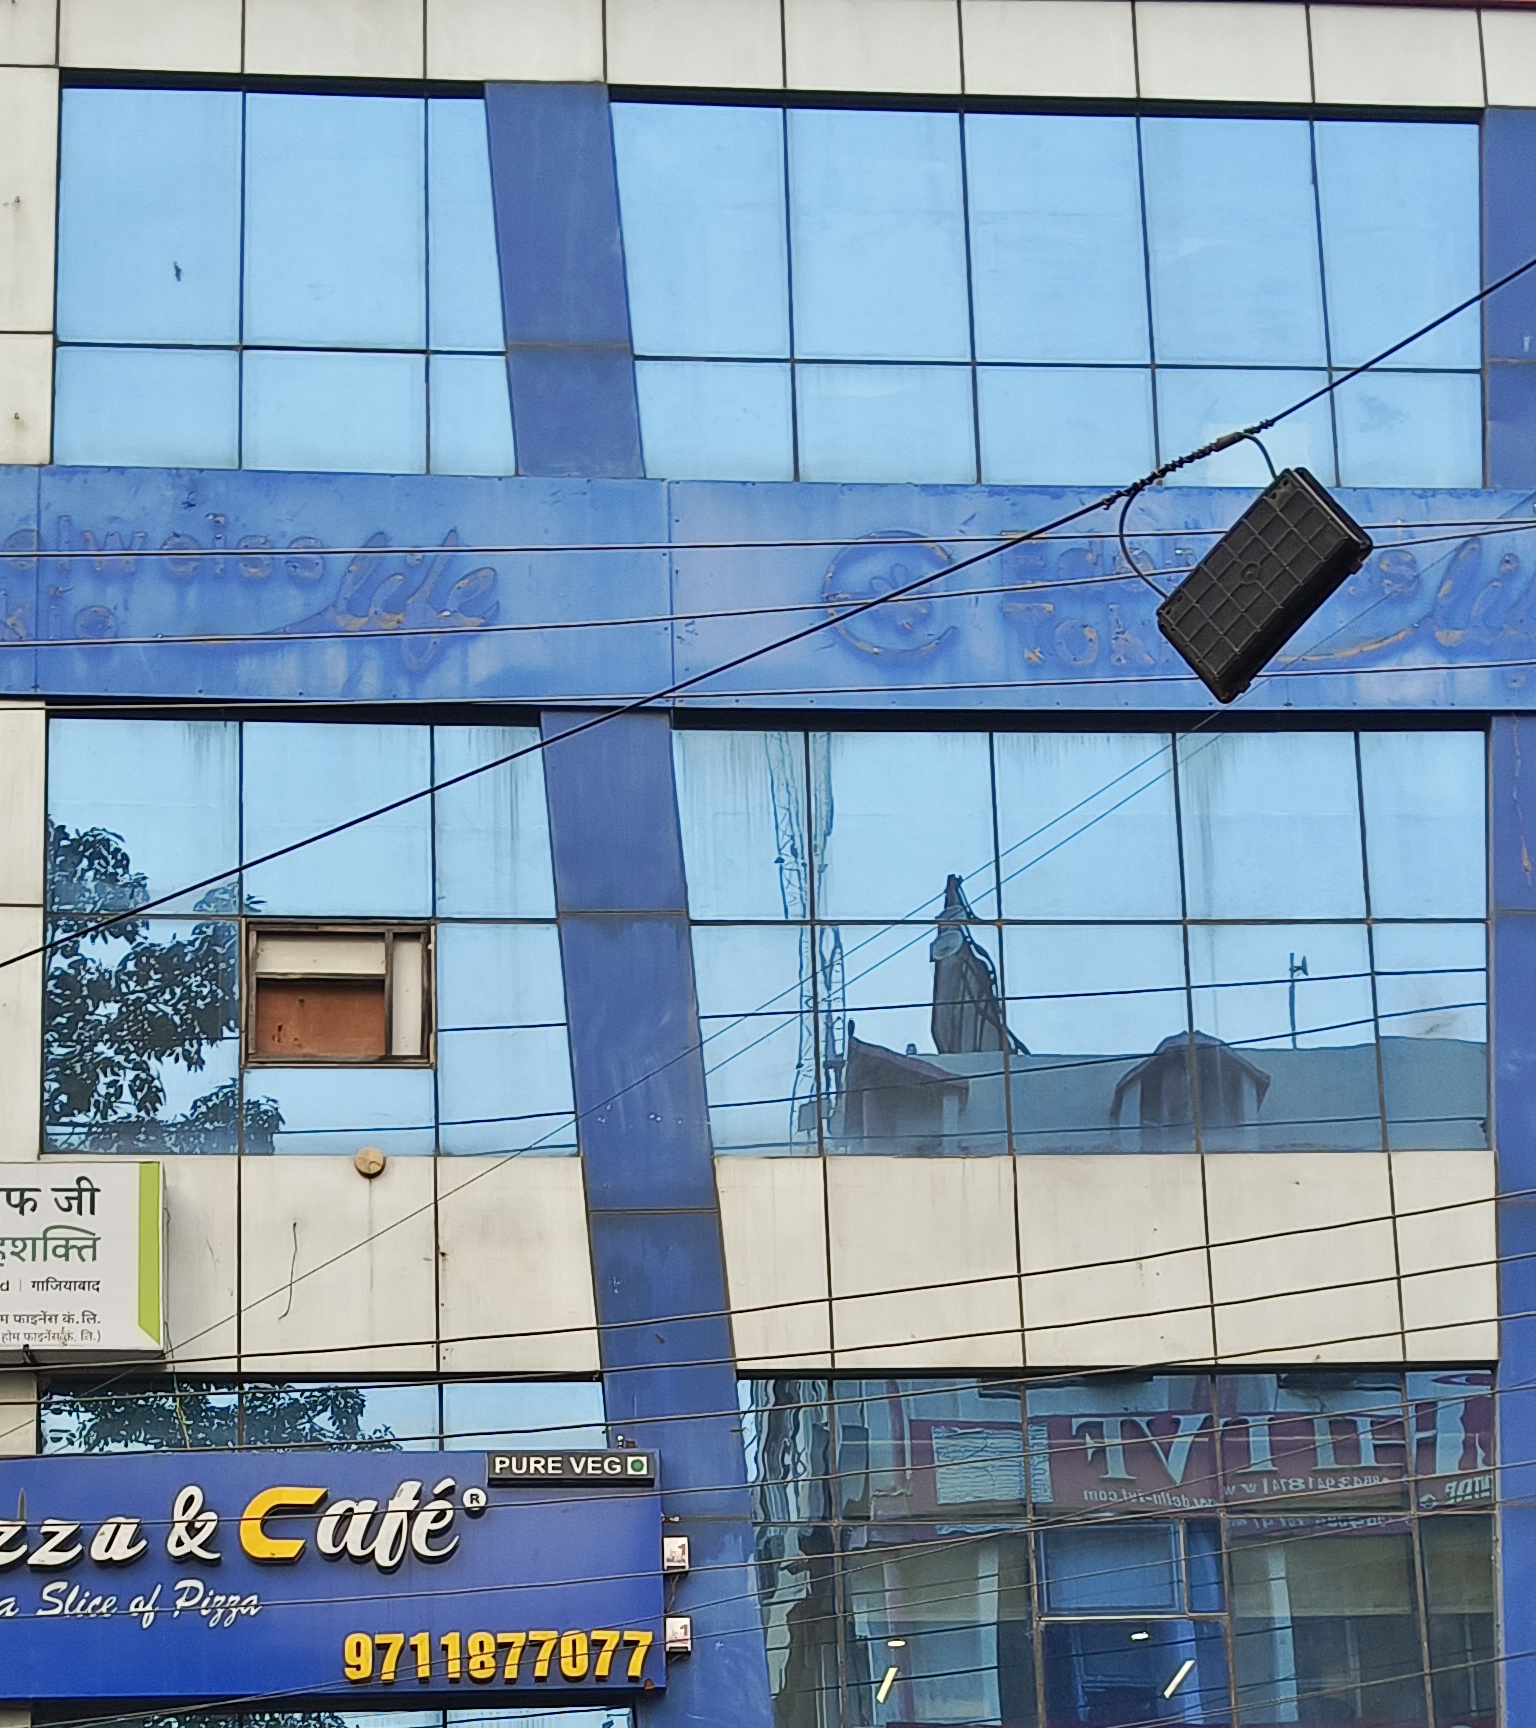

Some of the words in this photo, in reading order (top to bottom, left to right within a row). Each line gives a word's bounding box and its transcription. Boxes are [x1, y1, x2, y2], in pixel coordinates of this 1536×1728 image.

[50, 1176, 101, 1216] जी
[492, 1455, 564, 1474] PURE
[568, 1455, 623, 1474] VEG
[166, 1485, 223, 1562] &
[35, 1580, 119, 1618] Slice
[130, 1582, 163, 1630] of
[171, 1578, 262, 1629] Pizza
[343, 1629, 654, 1684] 9711877077
